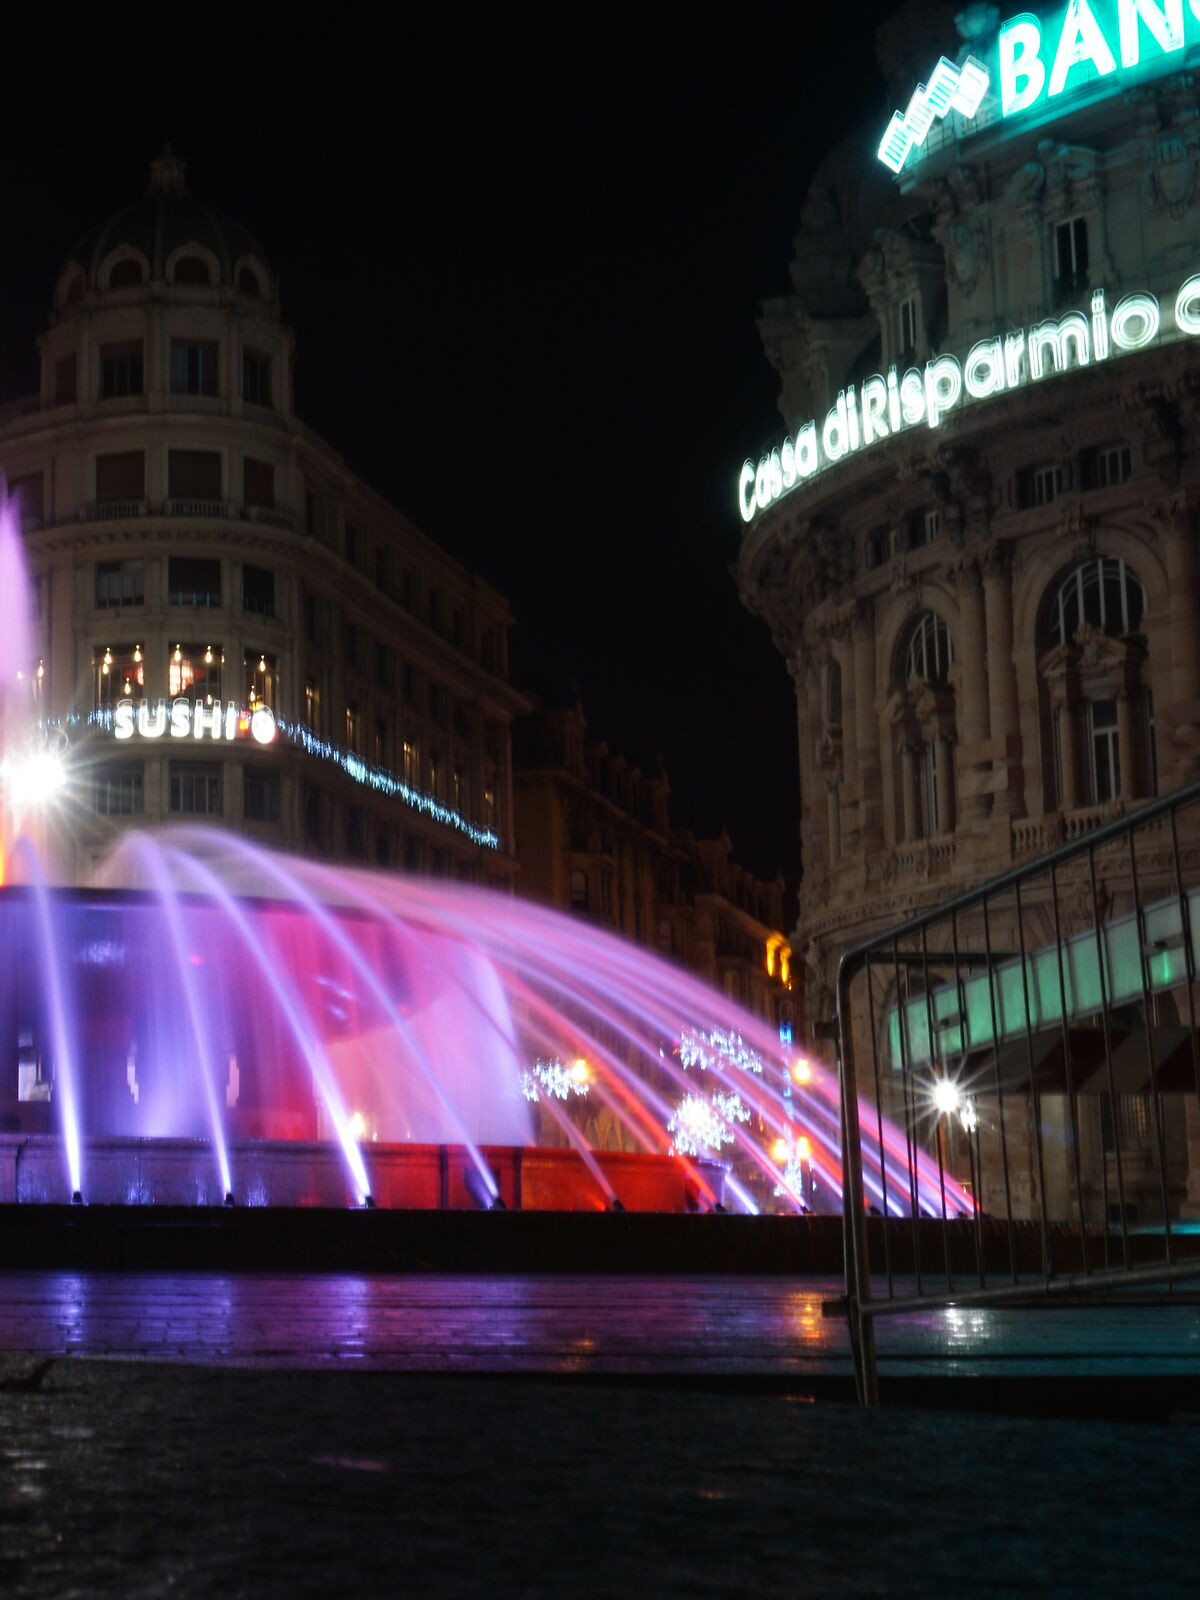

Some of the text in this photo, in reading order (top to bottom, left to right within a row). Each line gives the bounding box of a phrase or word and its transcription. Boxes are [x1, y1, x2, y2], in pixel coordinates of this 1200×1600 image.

[999, 0, 1200, 118] BAN
[739, 420, 818, 522] Cassa
[823, 385, 859, 460] di
[861, 288, 1160, 445] Risparmio
[114, 699, 237, 740] SUSHI
